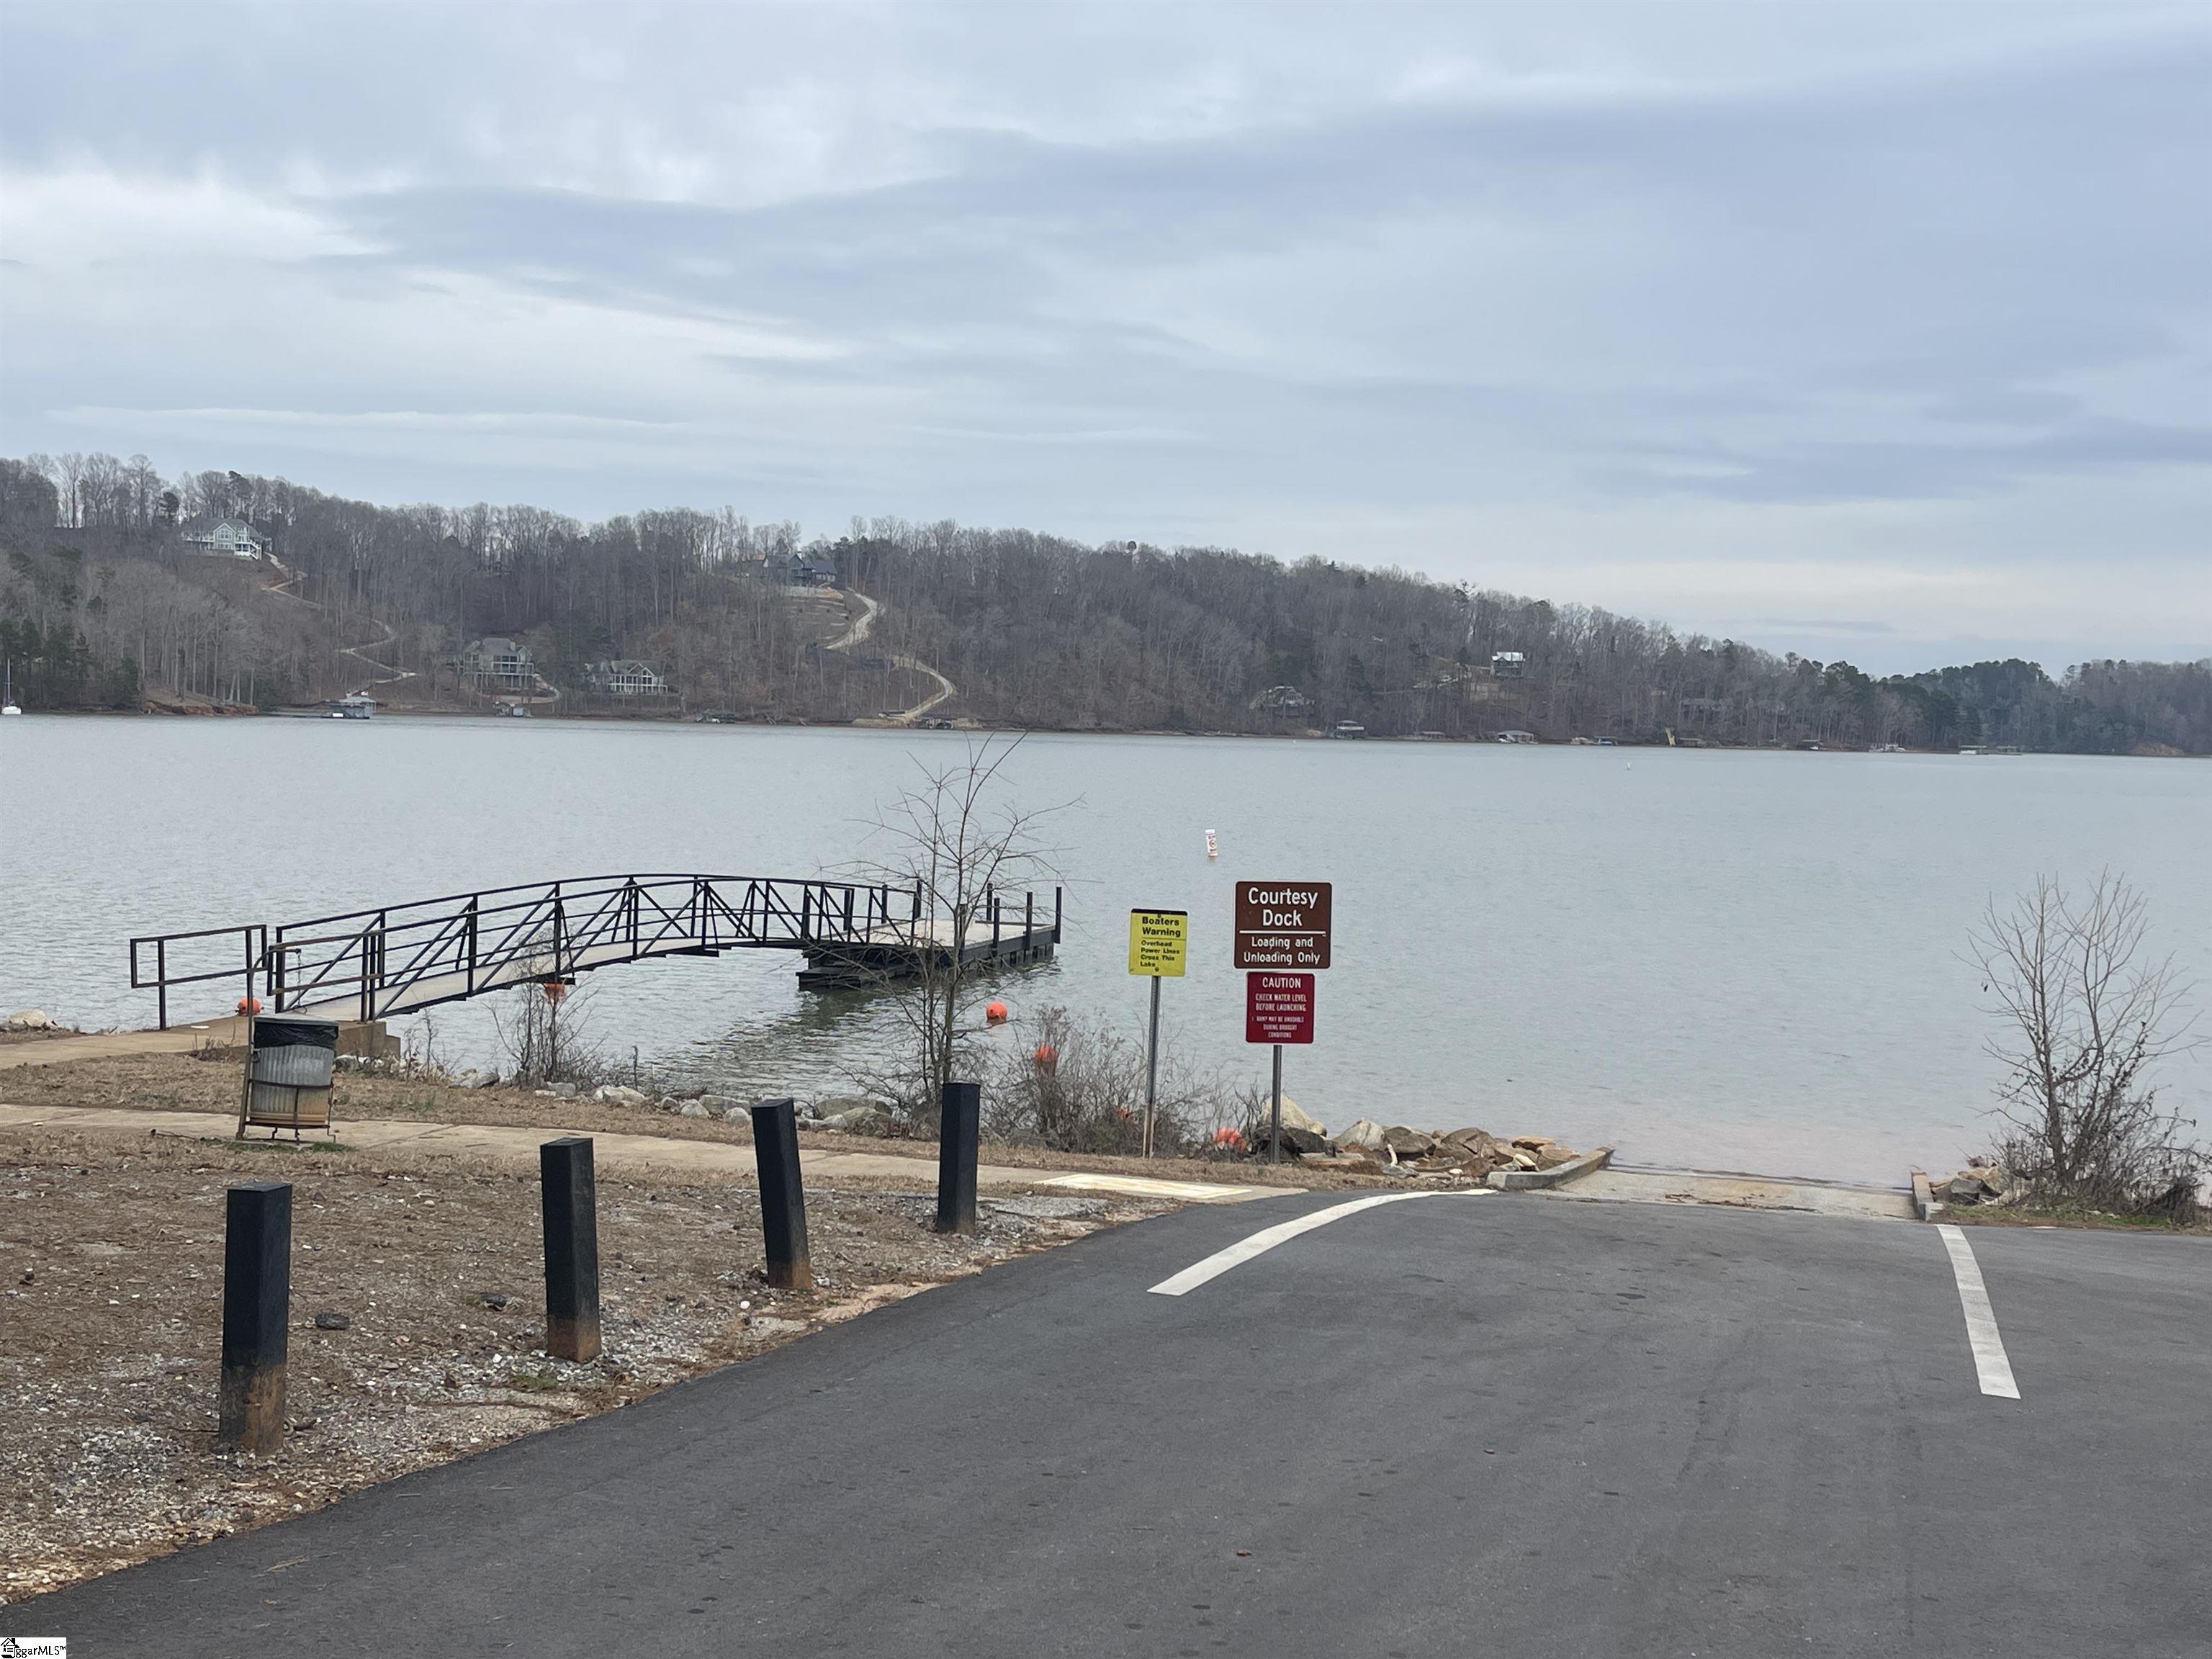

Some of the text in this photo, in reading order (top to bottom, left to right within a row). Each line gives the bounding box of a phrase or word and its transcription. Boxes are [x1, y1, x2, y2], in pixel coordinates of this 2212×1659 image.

[1248, 886, 1318, 909] Courtesy
[1142, 916, 1179, 926] Boaters
[1262, 909, 1303, 927] Dock
[1142, 927, 1181, 938] Warning
[1251, 936, 1313, 950] Loading and
[1244, 951, 1321, 966] Unloading Only
[1262, 977, 1301, 989] CAUTION
